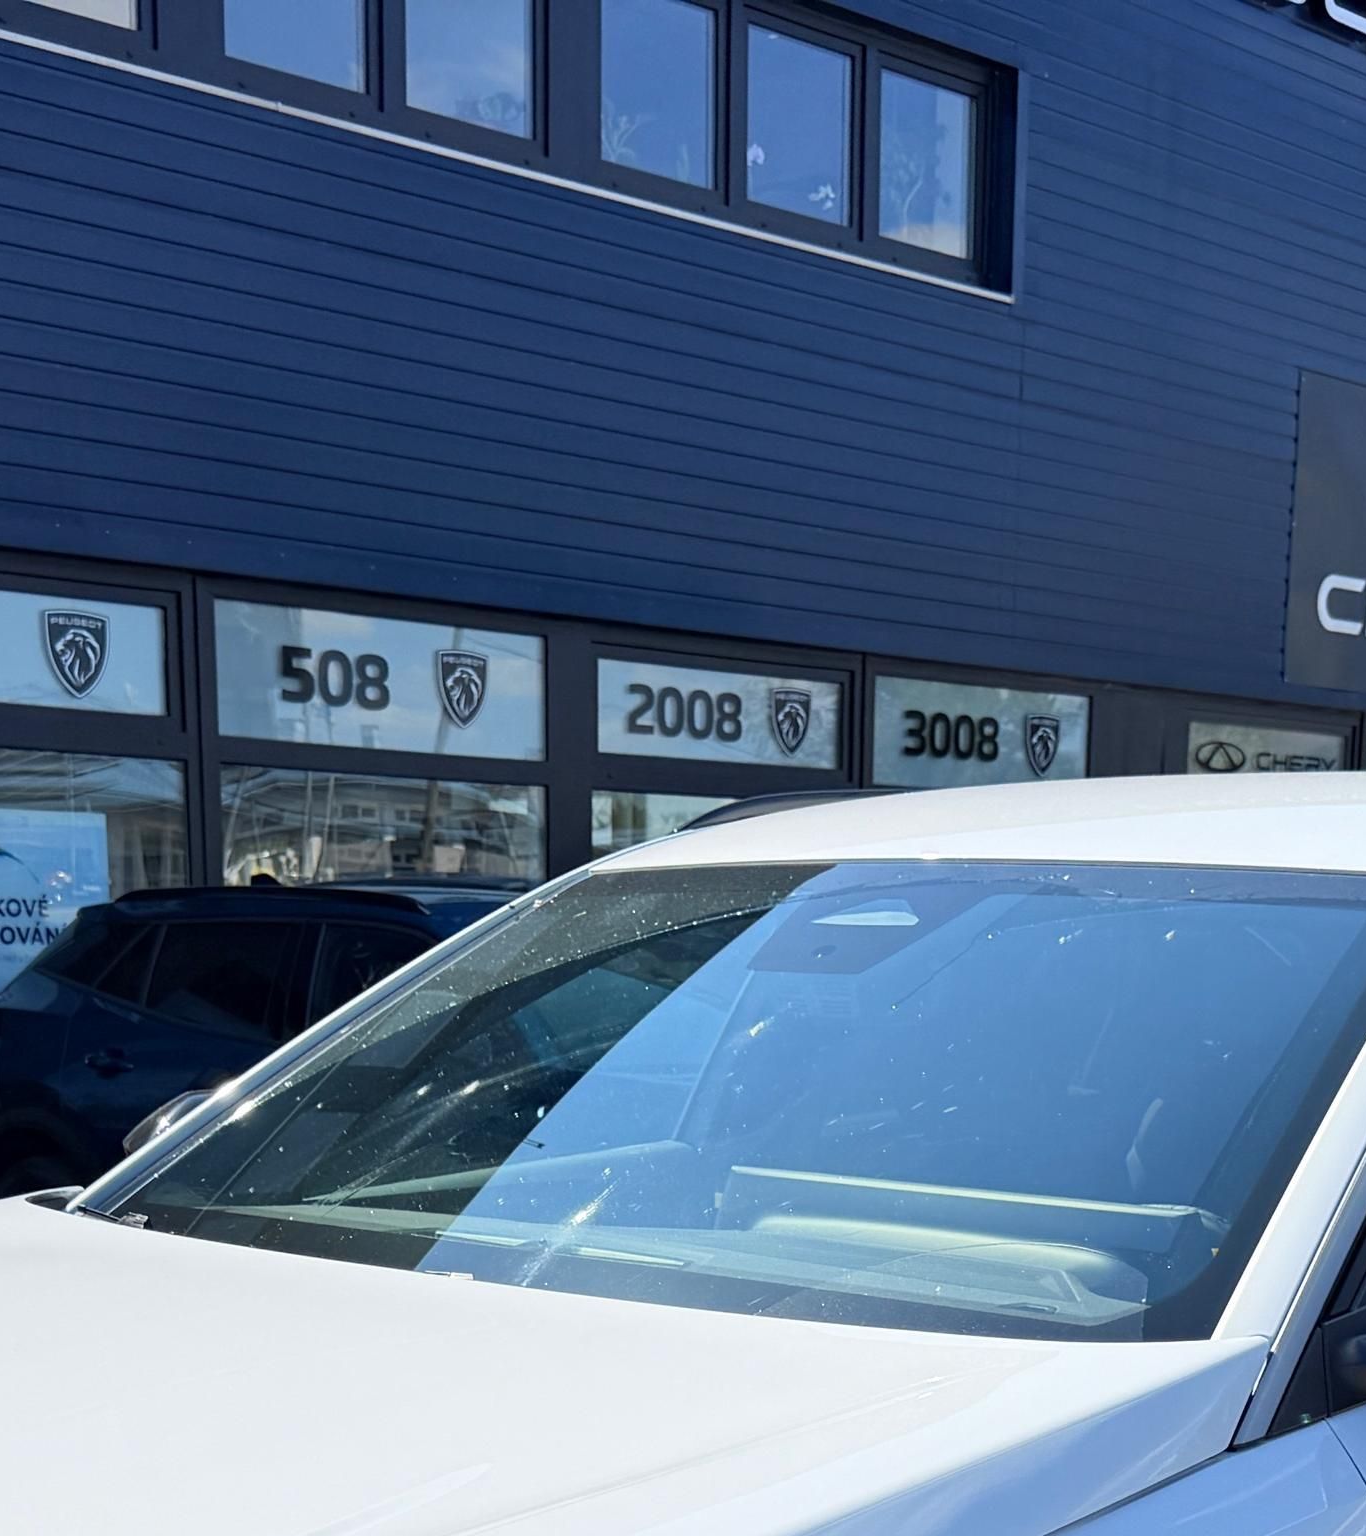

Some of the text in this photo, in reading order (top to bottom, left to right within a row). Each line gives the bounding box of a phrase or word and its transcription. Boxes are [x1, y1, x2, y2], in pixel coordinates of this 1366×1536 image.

[281, 645, 390, 711] 508
[627, 683, 743, 742] 2008
[903, 709, 1000, 762] 3008
[1255, 752, 1336, 771] CHERY
